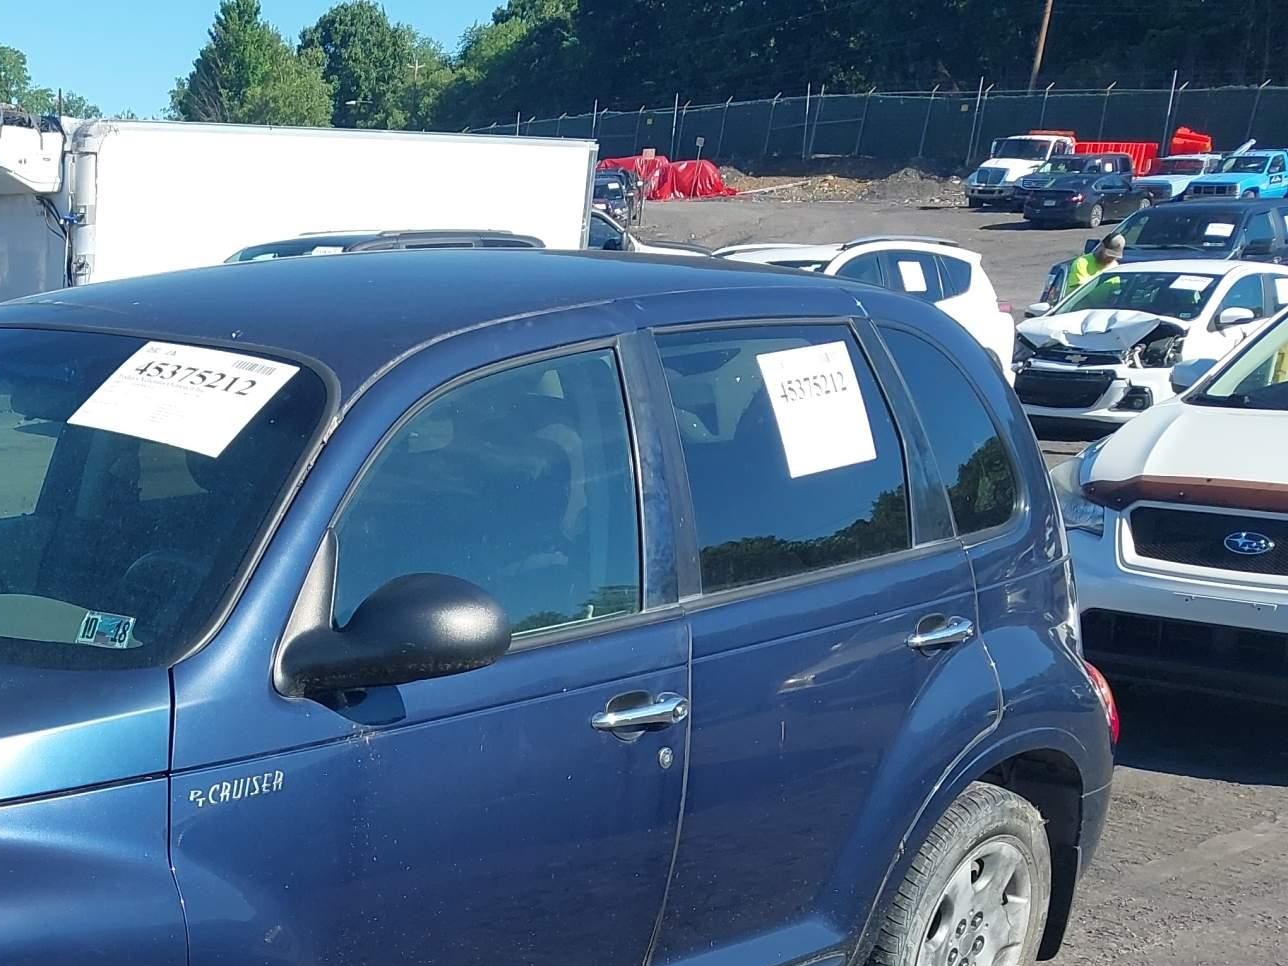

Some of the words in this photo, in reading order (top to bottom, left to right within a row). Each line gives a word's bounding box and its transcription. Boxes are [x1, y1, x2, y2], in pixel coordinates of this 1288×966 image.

[134, 360, 257, 396] 45375212
[780, 371, 847, 402] 45375212
[189, 790, 206, 807] PT
[208, 770, 284, 804] CRUISER
